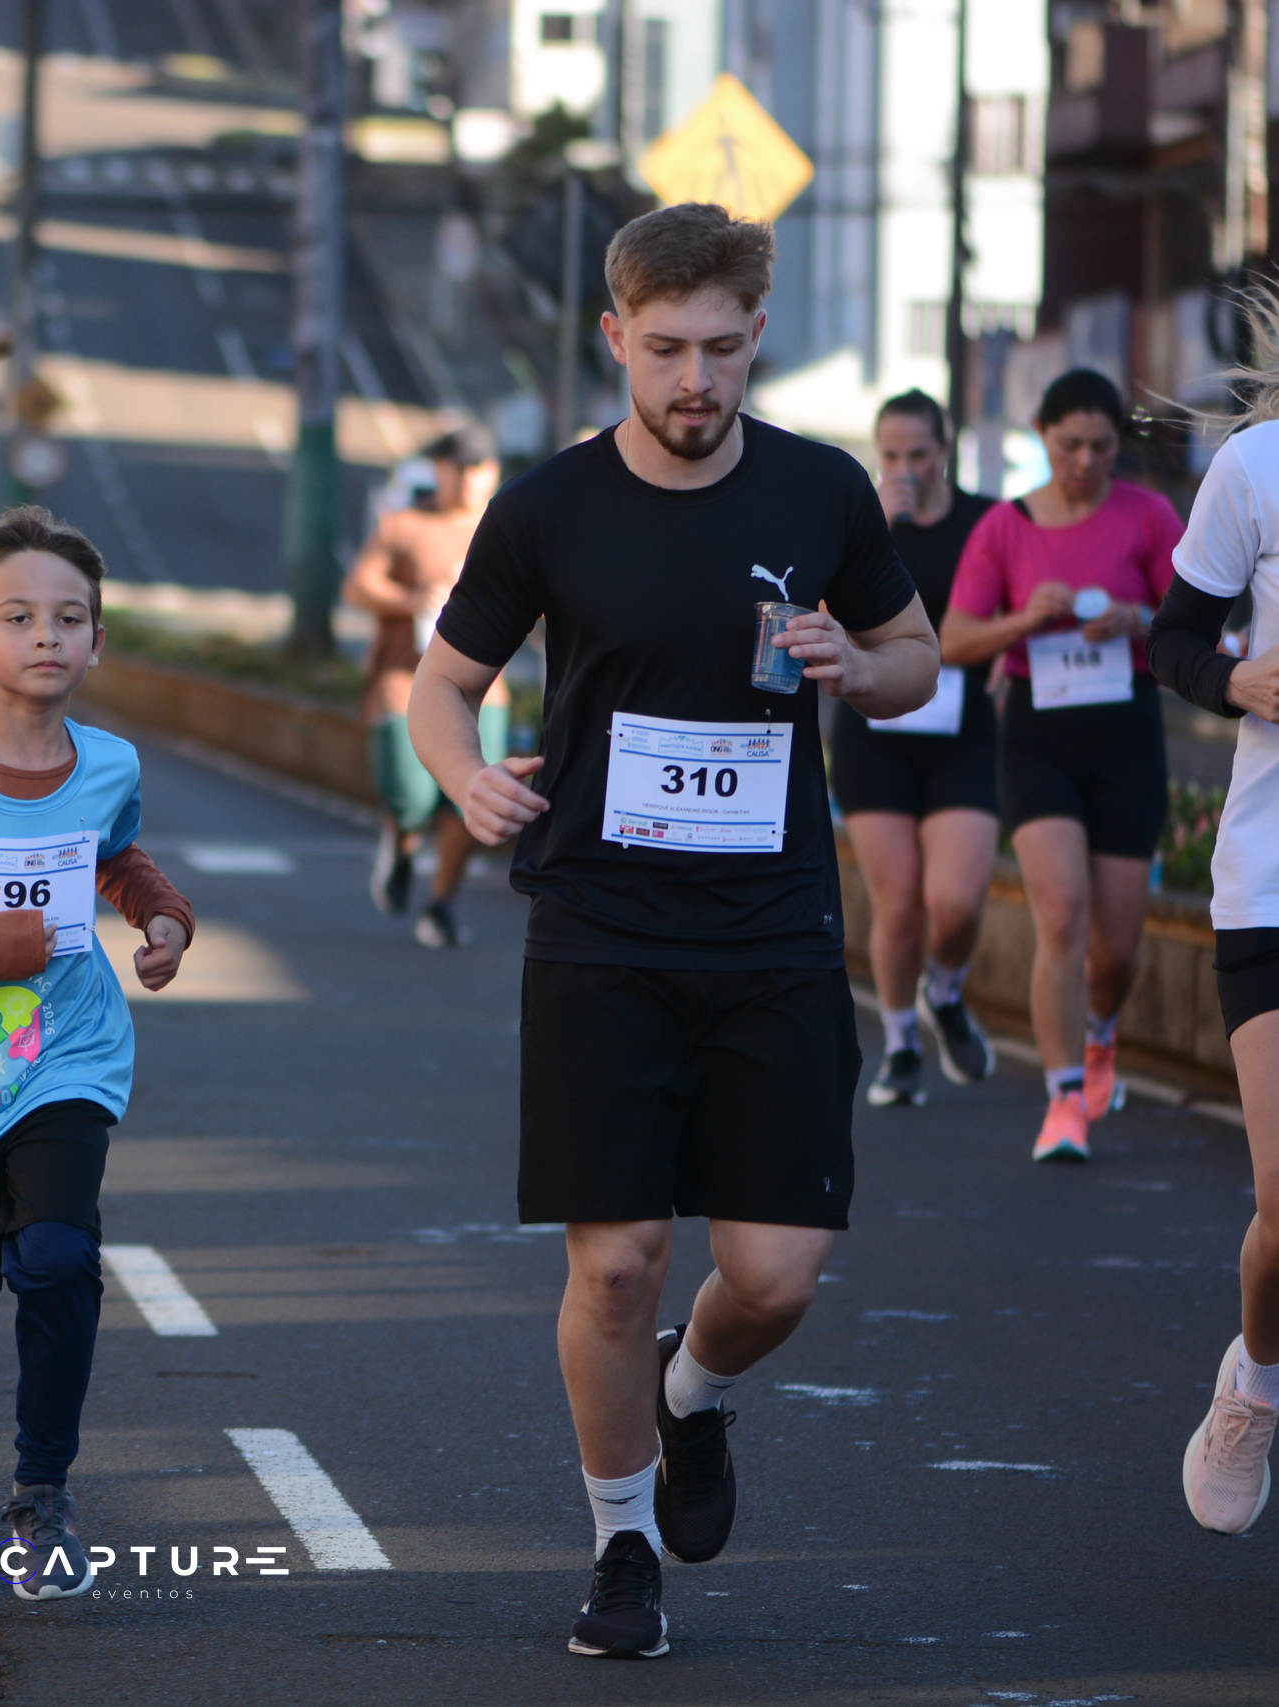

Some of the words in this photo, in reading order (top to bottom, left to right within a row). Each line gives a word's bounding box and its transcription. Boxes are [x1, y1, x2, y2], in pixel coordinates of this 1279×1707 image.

[660, 764, 738, 798] 310
[642, 802, 669, 811] HENRIQUE
[57, 858, 78, 867] CAUSA
[42, 1002, 56, 1036] 2026
